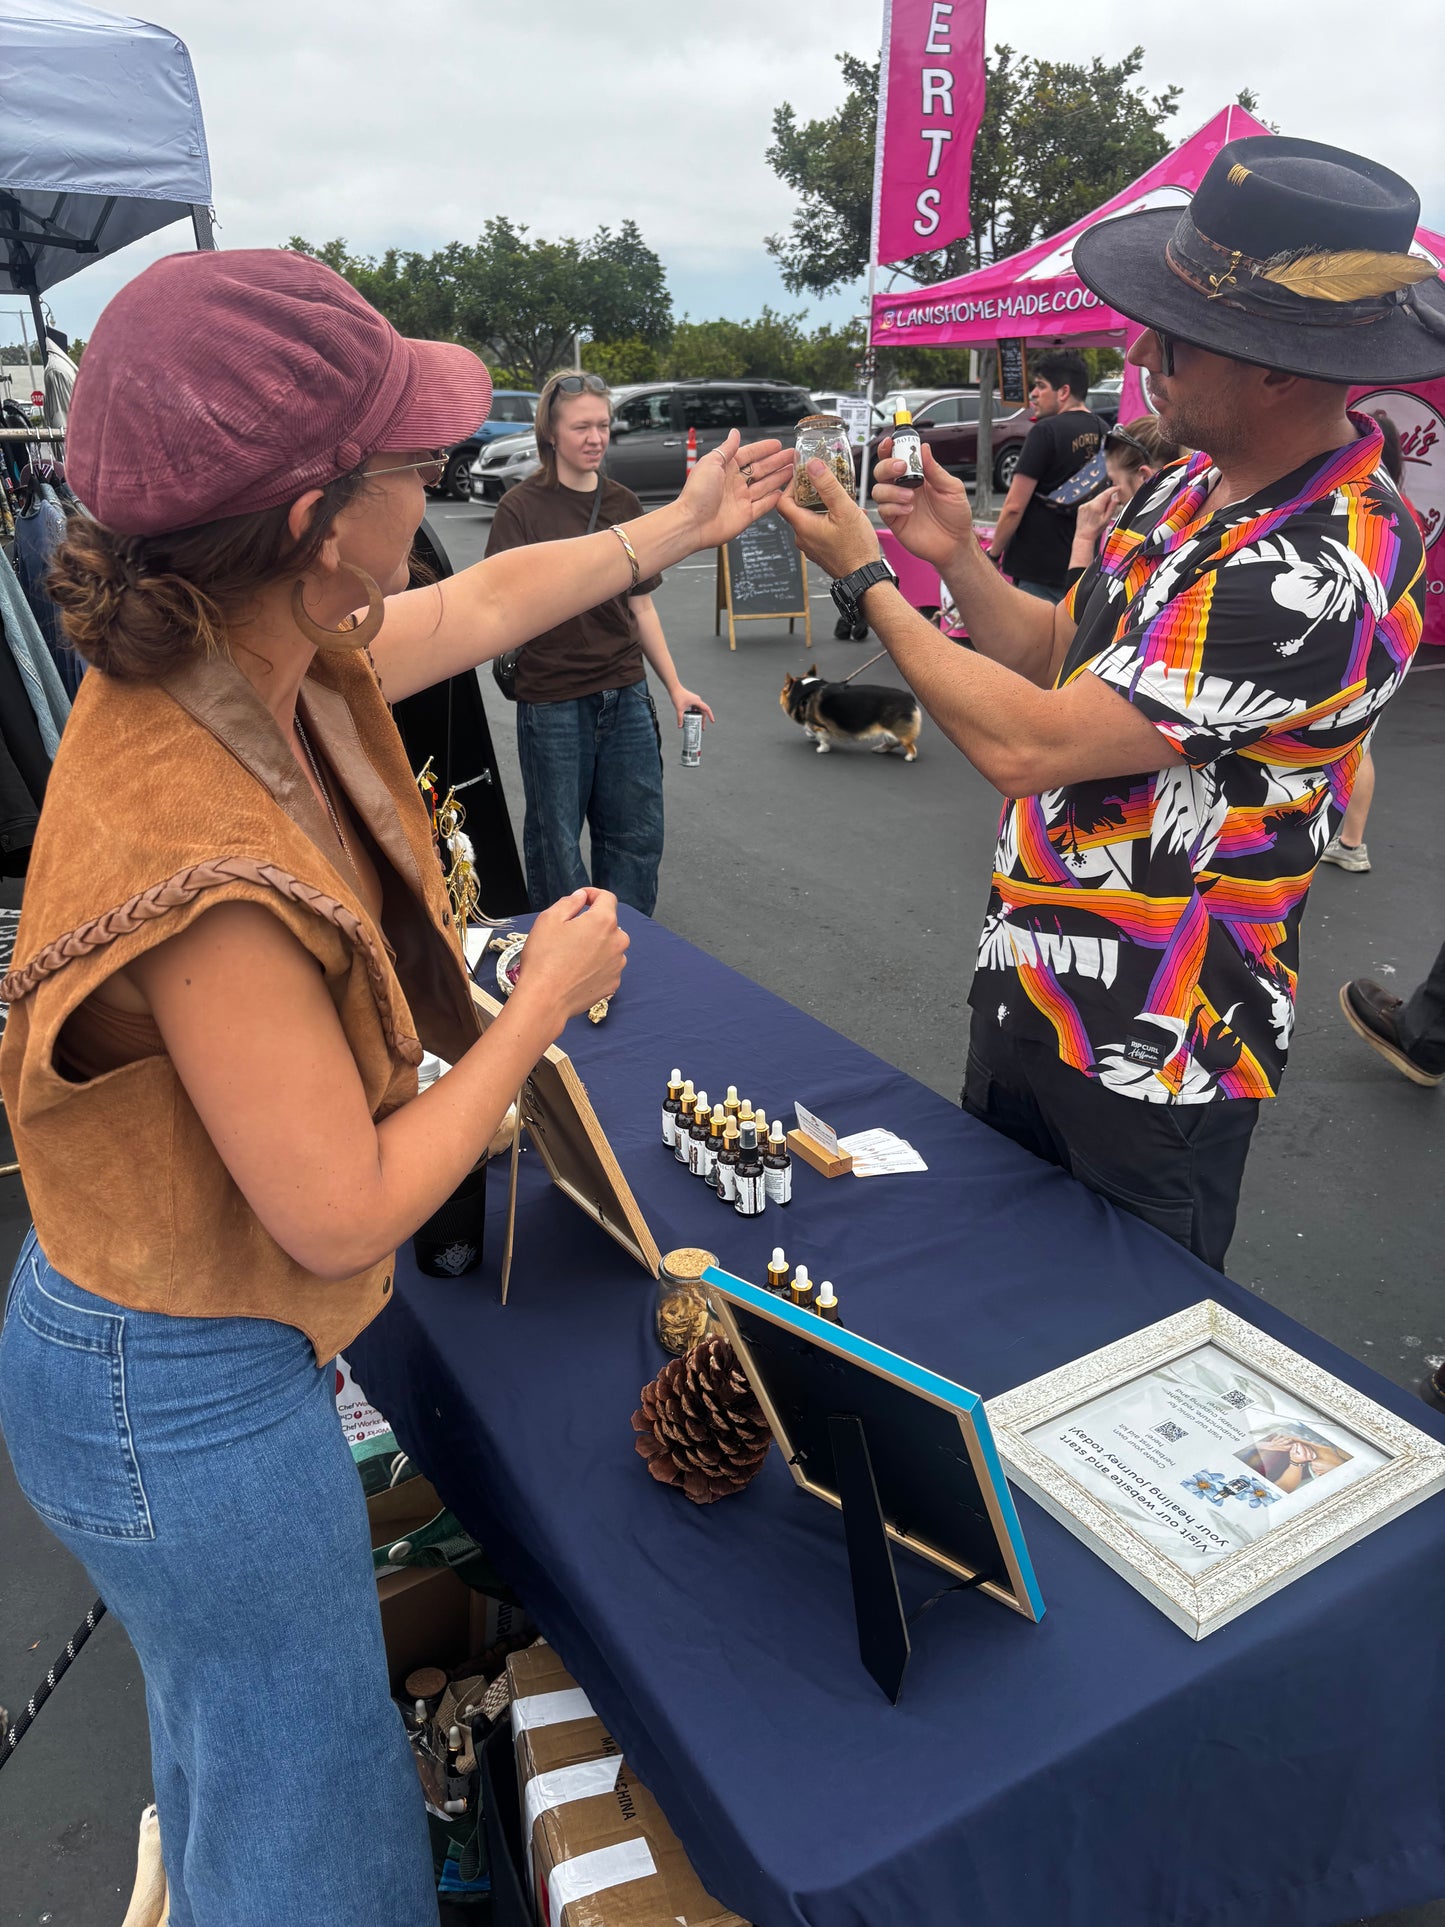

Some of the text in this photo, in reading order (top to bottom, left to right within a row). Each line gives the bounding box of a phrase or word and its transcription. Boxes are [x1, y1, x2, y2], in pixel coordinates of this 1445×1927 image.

[896, 287, 1105, 327] LANISHOMEMADECOO
[1130, 1041, 1159, 1055] RIP CURL
[338, 1403, 354, 1411] Chef
[1181, 1402, 1195, 1411] red
[357, 1419, 380, 1428] Works
[1167, 1401, 1223, 1440] Visit our clinic for
[1127, 1430, 1140, 1439] aid
[1145, 1434, 1164, 1447] here!
[1113, 1429, 1166, 1469] Create your own
[1139, 1438, 1154, 1450] first
[1152, 1449, 1176, 1466] herbal
[1060, 1435, 1207, 1552] Visit our website and start
[1068, 1426, 1229, 1547] your healing journey today!
[614, 1782, 637, 1821] CHINA
